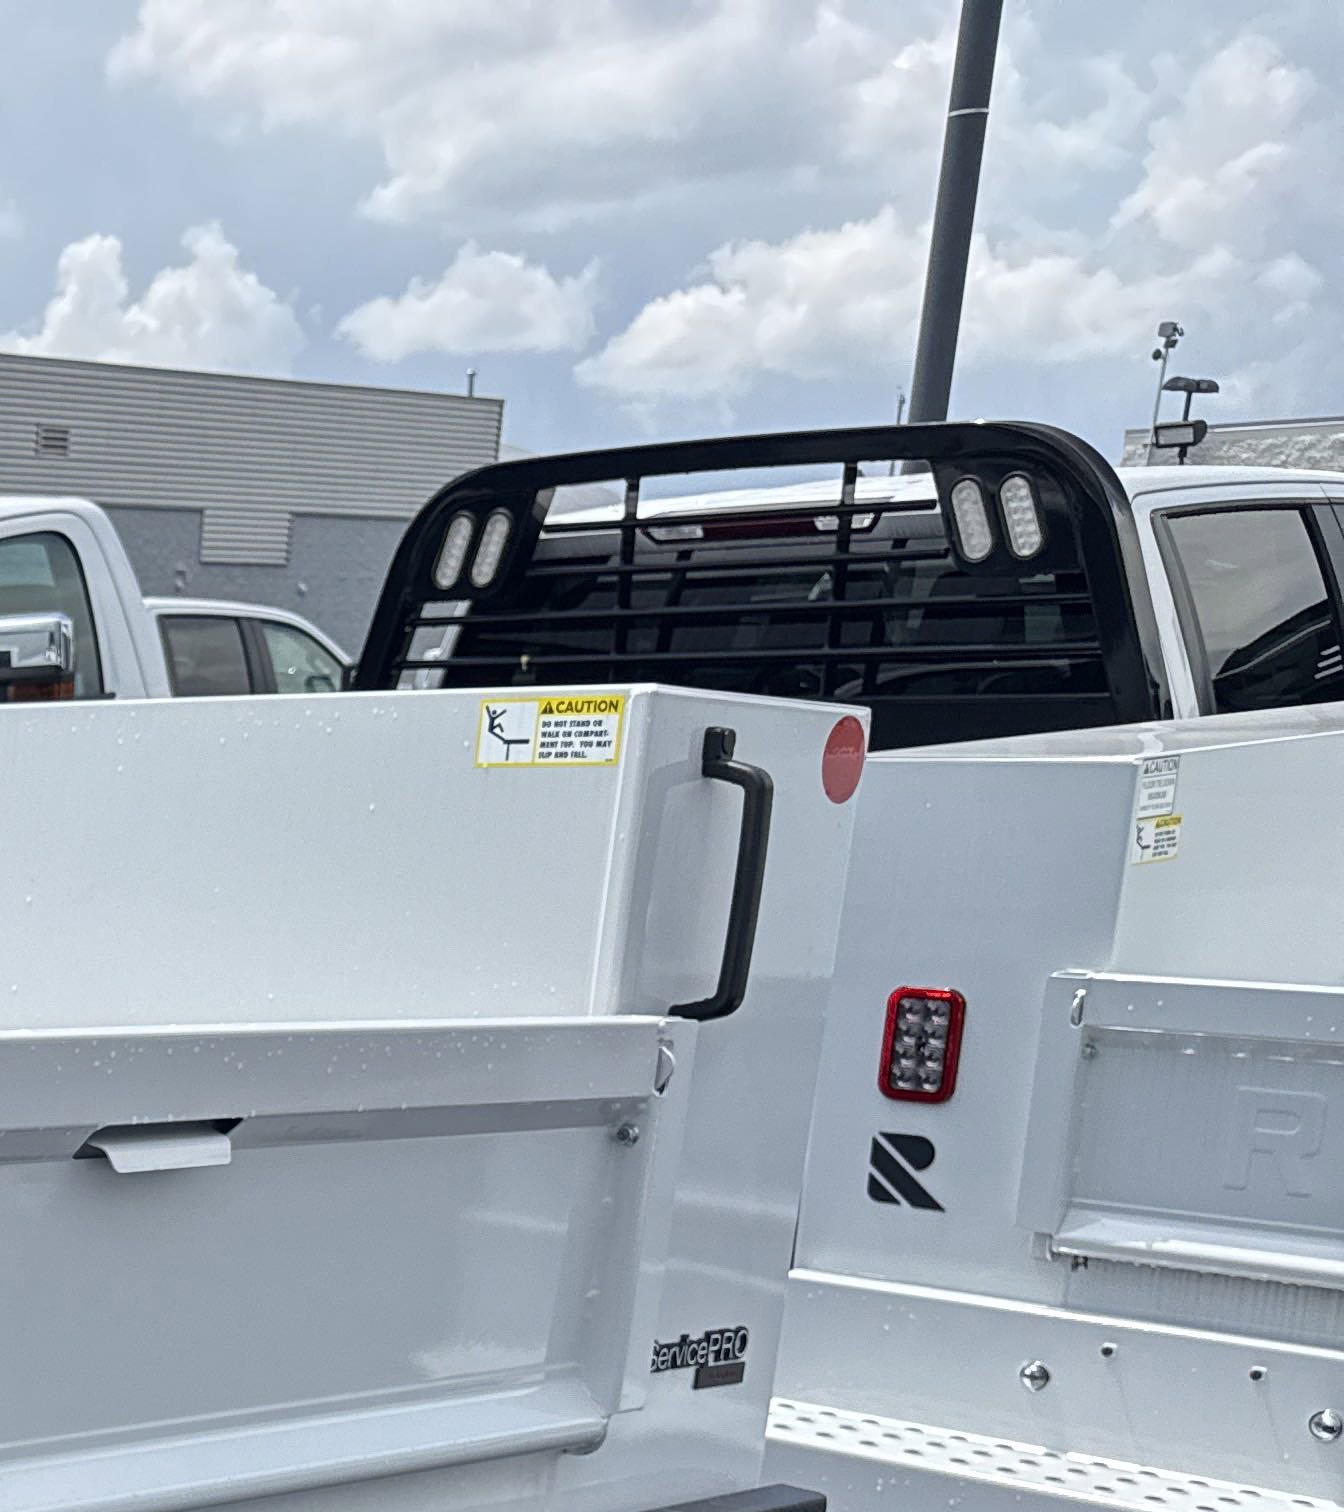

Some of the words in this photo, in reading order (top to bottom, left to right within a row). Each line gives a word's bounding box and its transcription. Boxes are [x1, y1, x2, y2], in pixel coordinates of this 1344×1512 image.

[556, 699, 619, 714] CAUTION
[541, 720, 552, 729] DO
[554, 720, 568, 728] NOT
[569, 719, 591, 728] STAND
[592, 719, 603, 728] OR
[561, 730, 572, 738] ON
[579, 740, 595, 749] YOU
[596, 740, 613, 748] MAY
[553, 751, 569, 759] AND
[650, 1327, 748, 1373] ServicePRO
